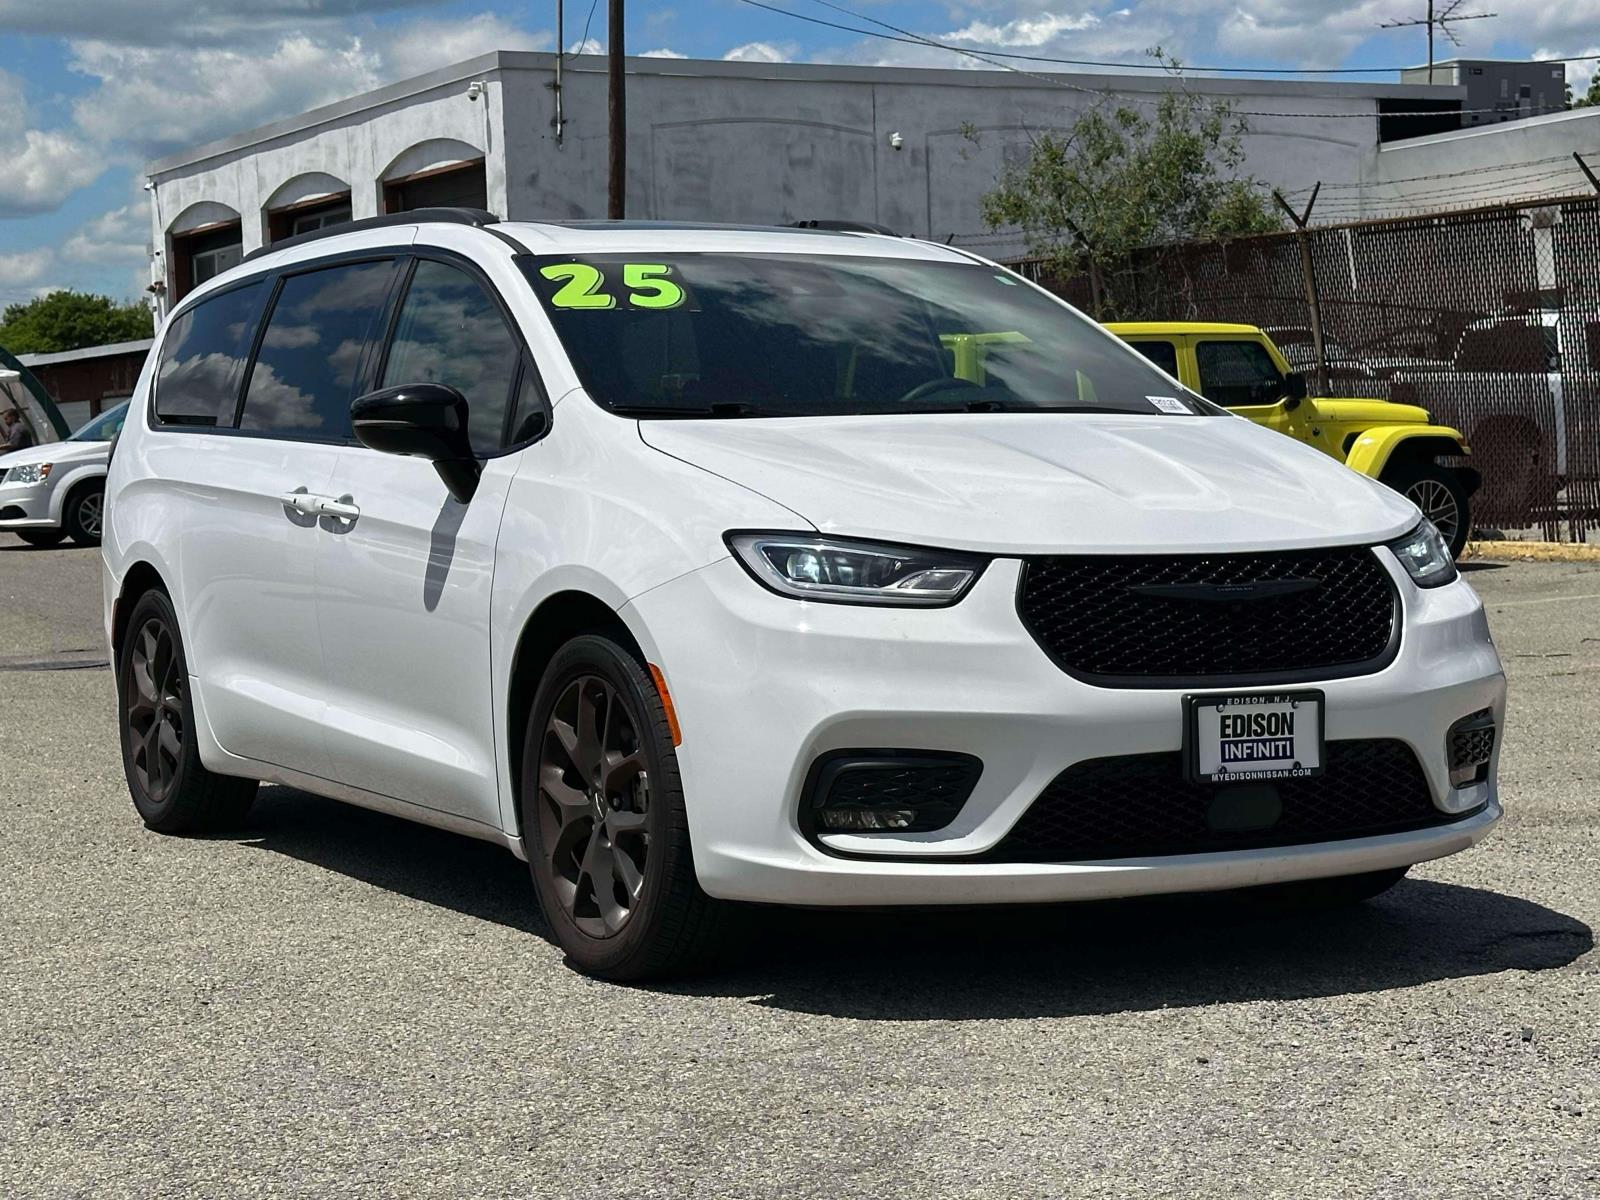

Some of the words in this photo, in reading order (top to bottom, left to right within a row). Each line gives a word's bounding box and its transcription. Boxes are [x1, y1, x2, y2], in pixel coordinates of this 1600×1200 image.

[540, 264, 686, 309] 25
[1220, 712, 1294, 738] EDISON
[1225, 741, 1290, 759] INFINITI
[1211, 769, 1312, 782] MYEDISONNISSAN.COM
